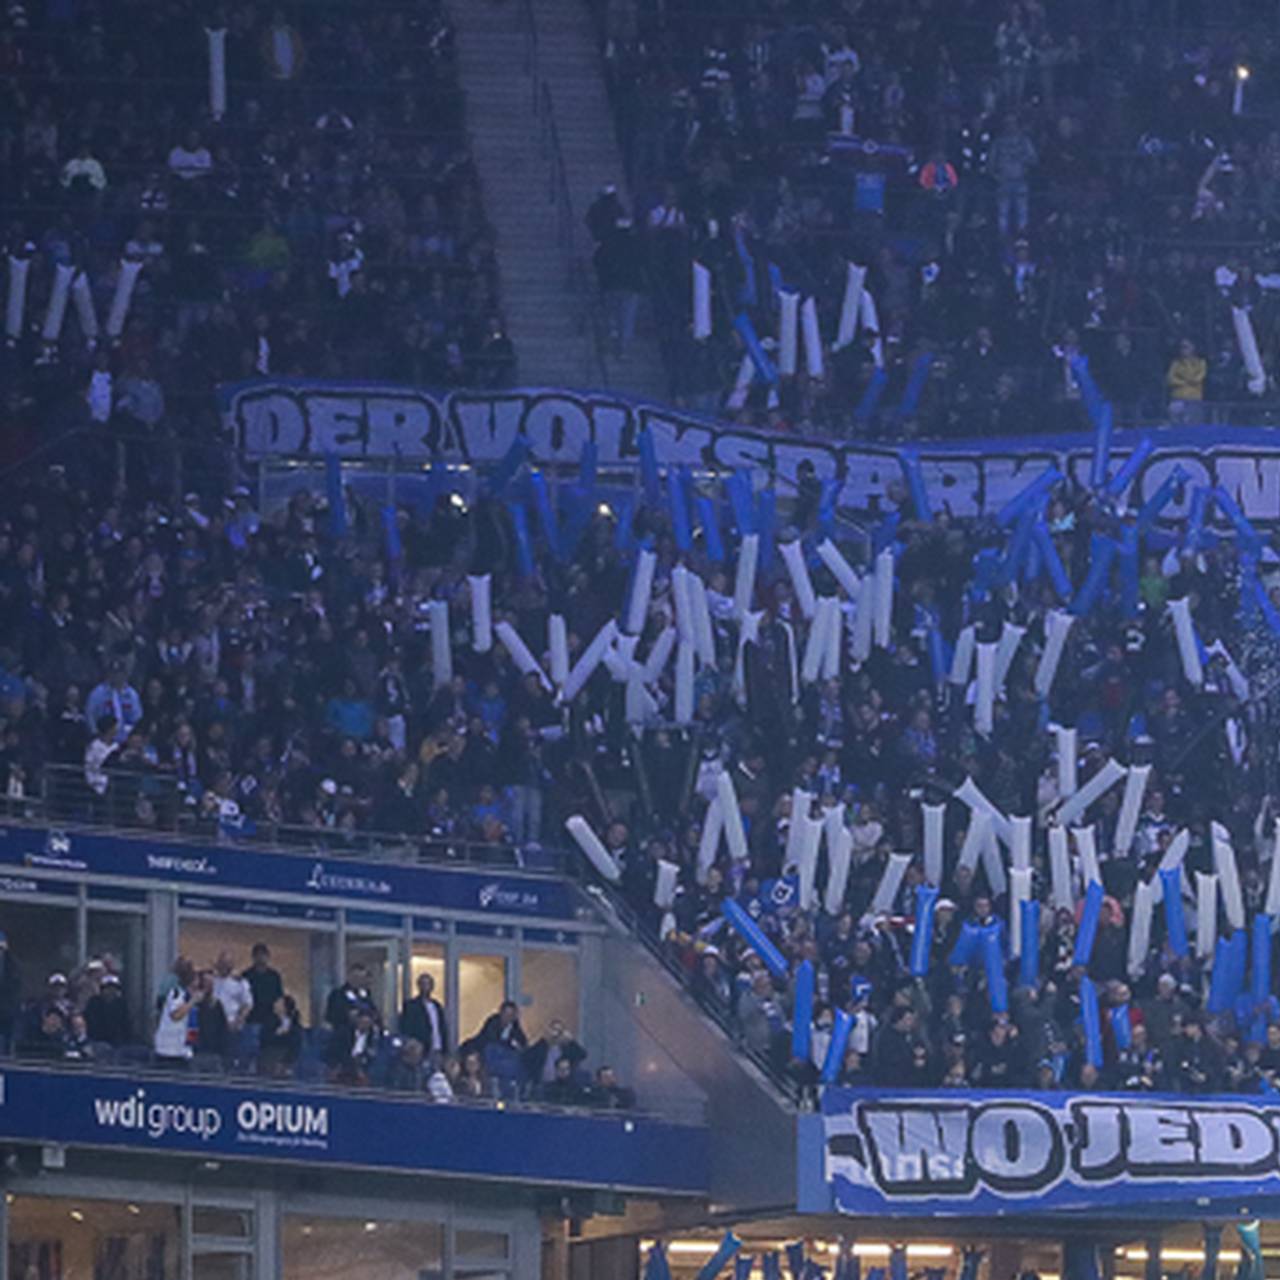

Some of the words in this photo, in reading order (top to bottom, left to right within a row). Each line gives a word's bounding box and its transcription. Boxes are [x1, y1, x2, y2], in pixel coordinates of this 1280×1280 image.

[242, 398, 433, 457] DER
[236, 1101, 327, 1136] OPIUM
[866, 1107, 1053, 1182] WO
